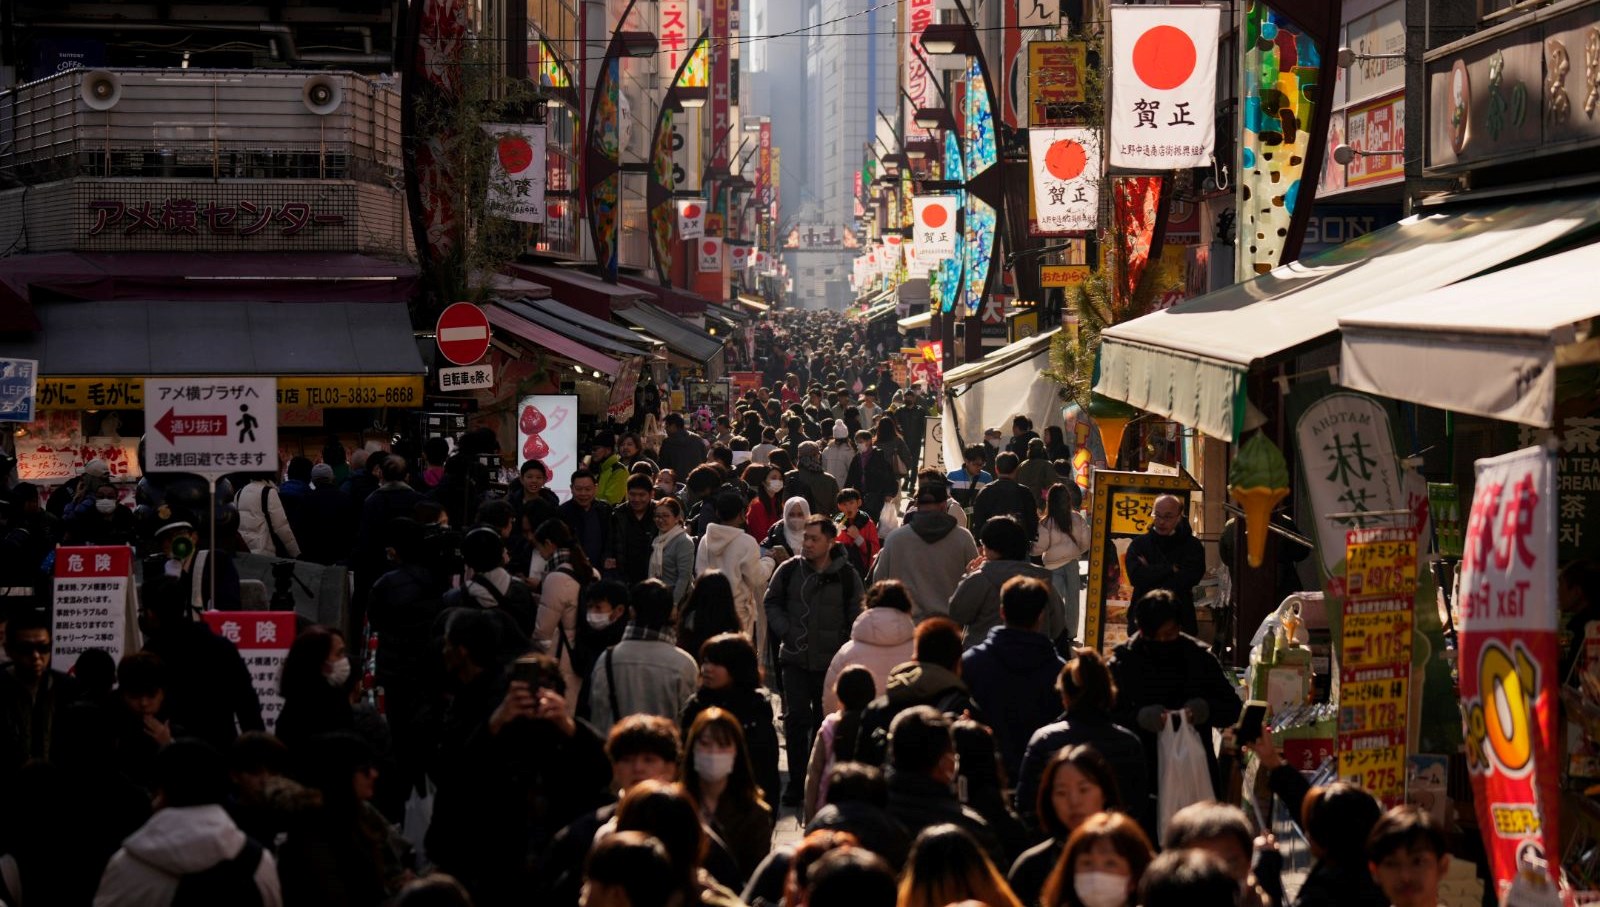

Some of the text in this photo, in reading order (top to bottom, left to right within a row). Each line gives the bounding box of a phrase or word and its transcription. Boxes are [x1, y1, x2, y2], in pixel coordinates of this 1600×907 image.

[1133, 98, 1195, 129] 賀正
[1047, 186, 1088, 206] 賀正
[89, 199, 346, 235] アメ横センター
[443, 370, 490, 387] 自転車を除く
[3, 385, 30, 396] LEFT
[37, 383, 76, 404] がに
[88, 382, 141, 405] 毛がに
[306, 386, 414, 405] TEL03-3833-6668
[158, 385, 259, 402] アメ横プラザへ
[170, 419, 222, 434] 通り抜け
[155, 452, 267, 468] 混雑回避できます
[1572, 458, 1600, 473] TEA
[1561, 494, 1586, 519] 茶
[1559, 523, 1583, 549] 차
[68, 553, 112, 573] 危険
[56, 608, 108, 618] 事故やトラブルの
[56, 621, 115, 630] 原因となりますので
[220, 620, 278, 644] 危険
[56, 633, 114, 642] キャリーケース等の
[1344, 747, 1398, 767] サンテFX
[1367, 768, 1397, 791] 275
